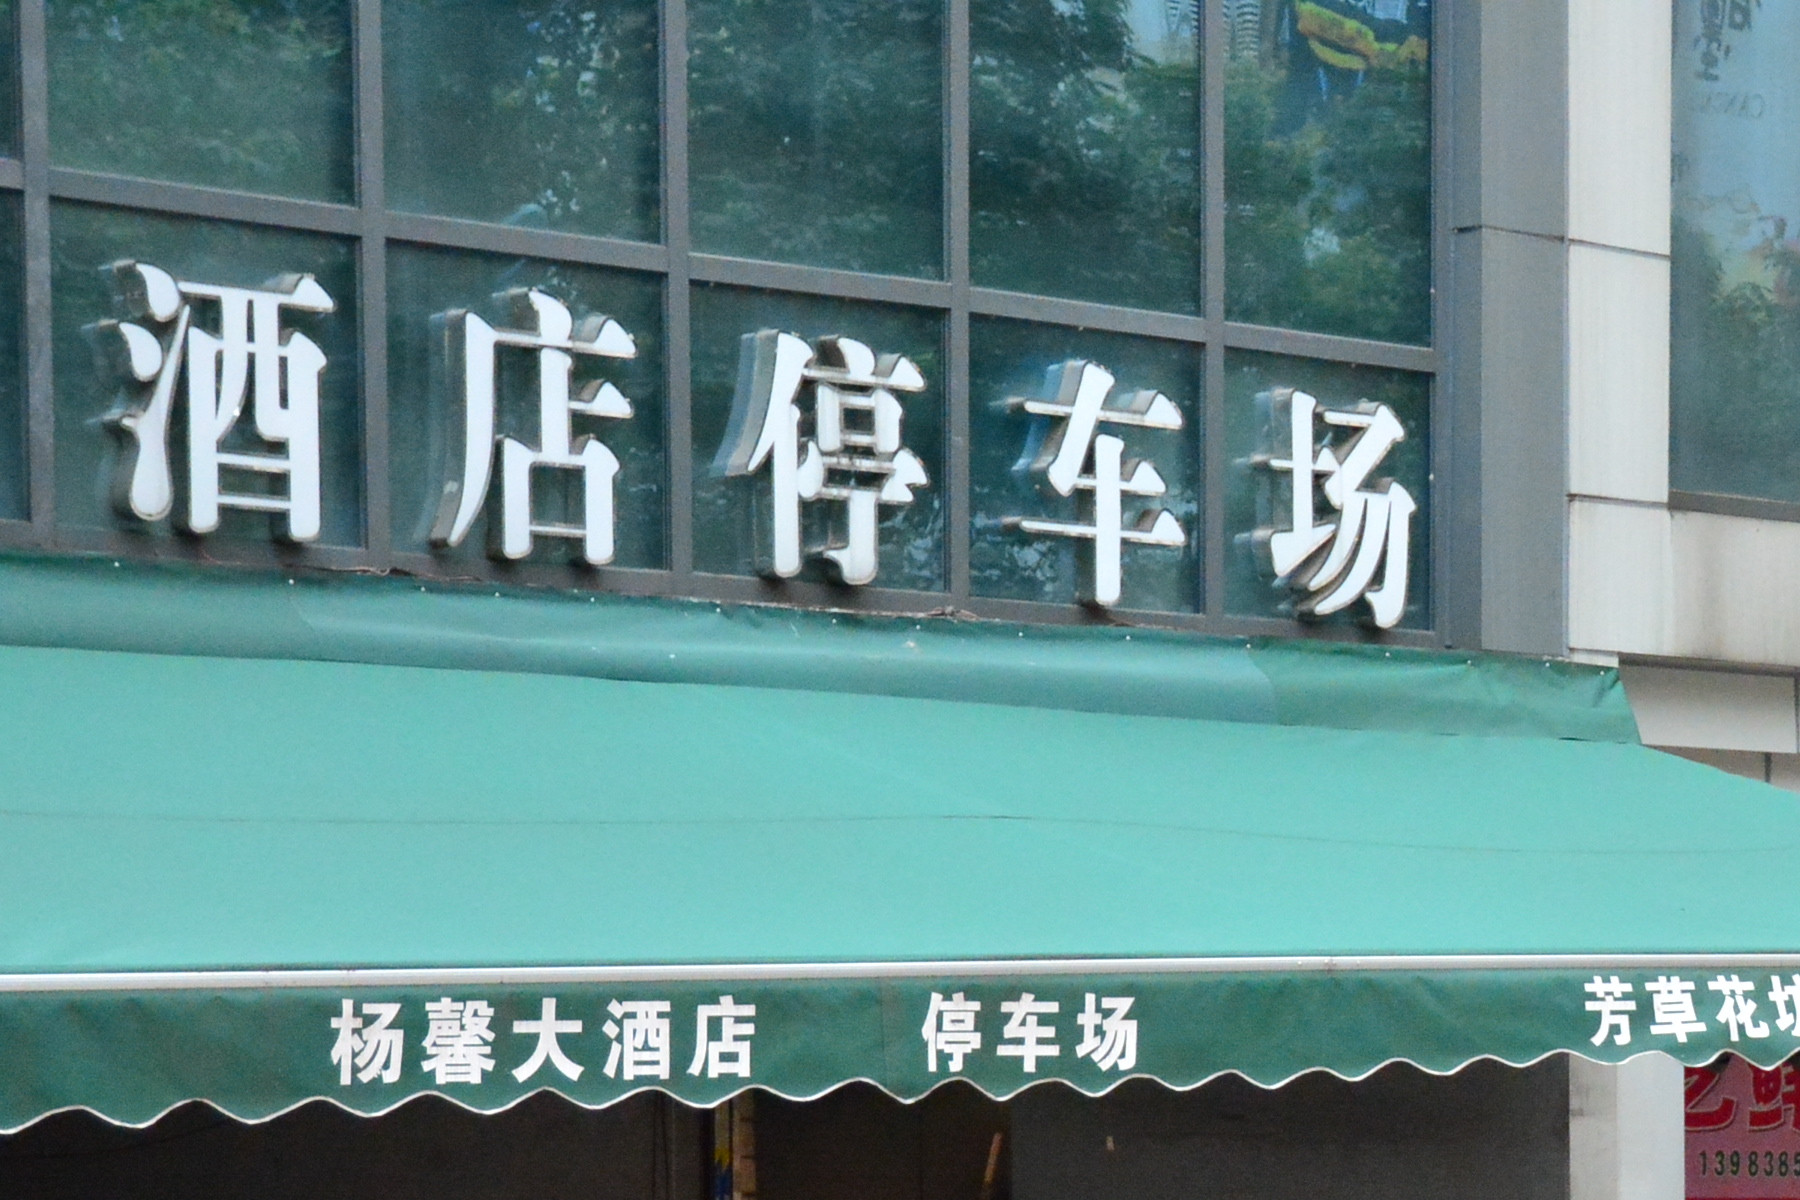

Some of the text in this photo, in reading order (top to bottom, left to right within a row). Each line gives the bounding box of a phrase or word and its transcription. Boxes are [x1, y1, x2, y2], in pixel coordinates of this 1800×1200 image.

[113, 260, 1418, 629] 酒店停车场
[331, 992, 1138, 1085] 杨馨大酒店 停车场
